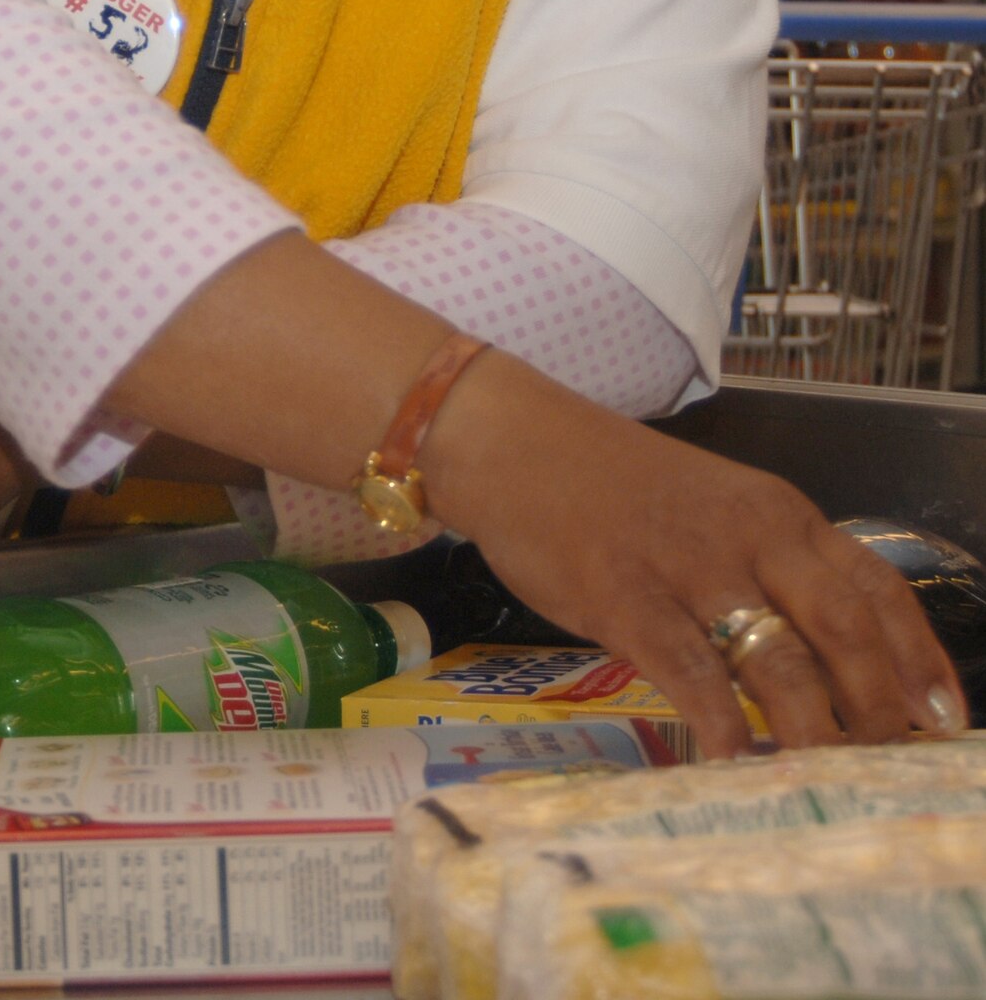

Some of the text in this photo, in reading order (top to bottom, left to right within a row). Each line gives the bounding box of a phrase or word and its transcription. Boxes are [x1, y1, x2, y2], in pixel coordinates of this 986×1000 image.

[423, 656, 538, 683] Blue
[460, 651, 610, 697] Bonnet
[212, 671, 258, 732] De
[264, 680, 287, 721] Diet
